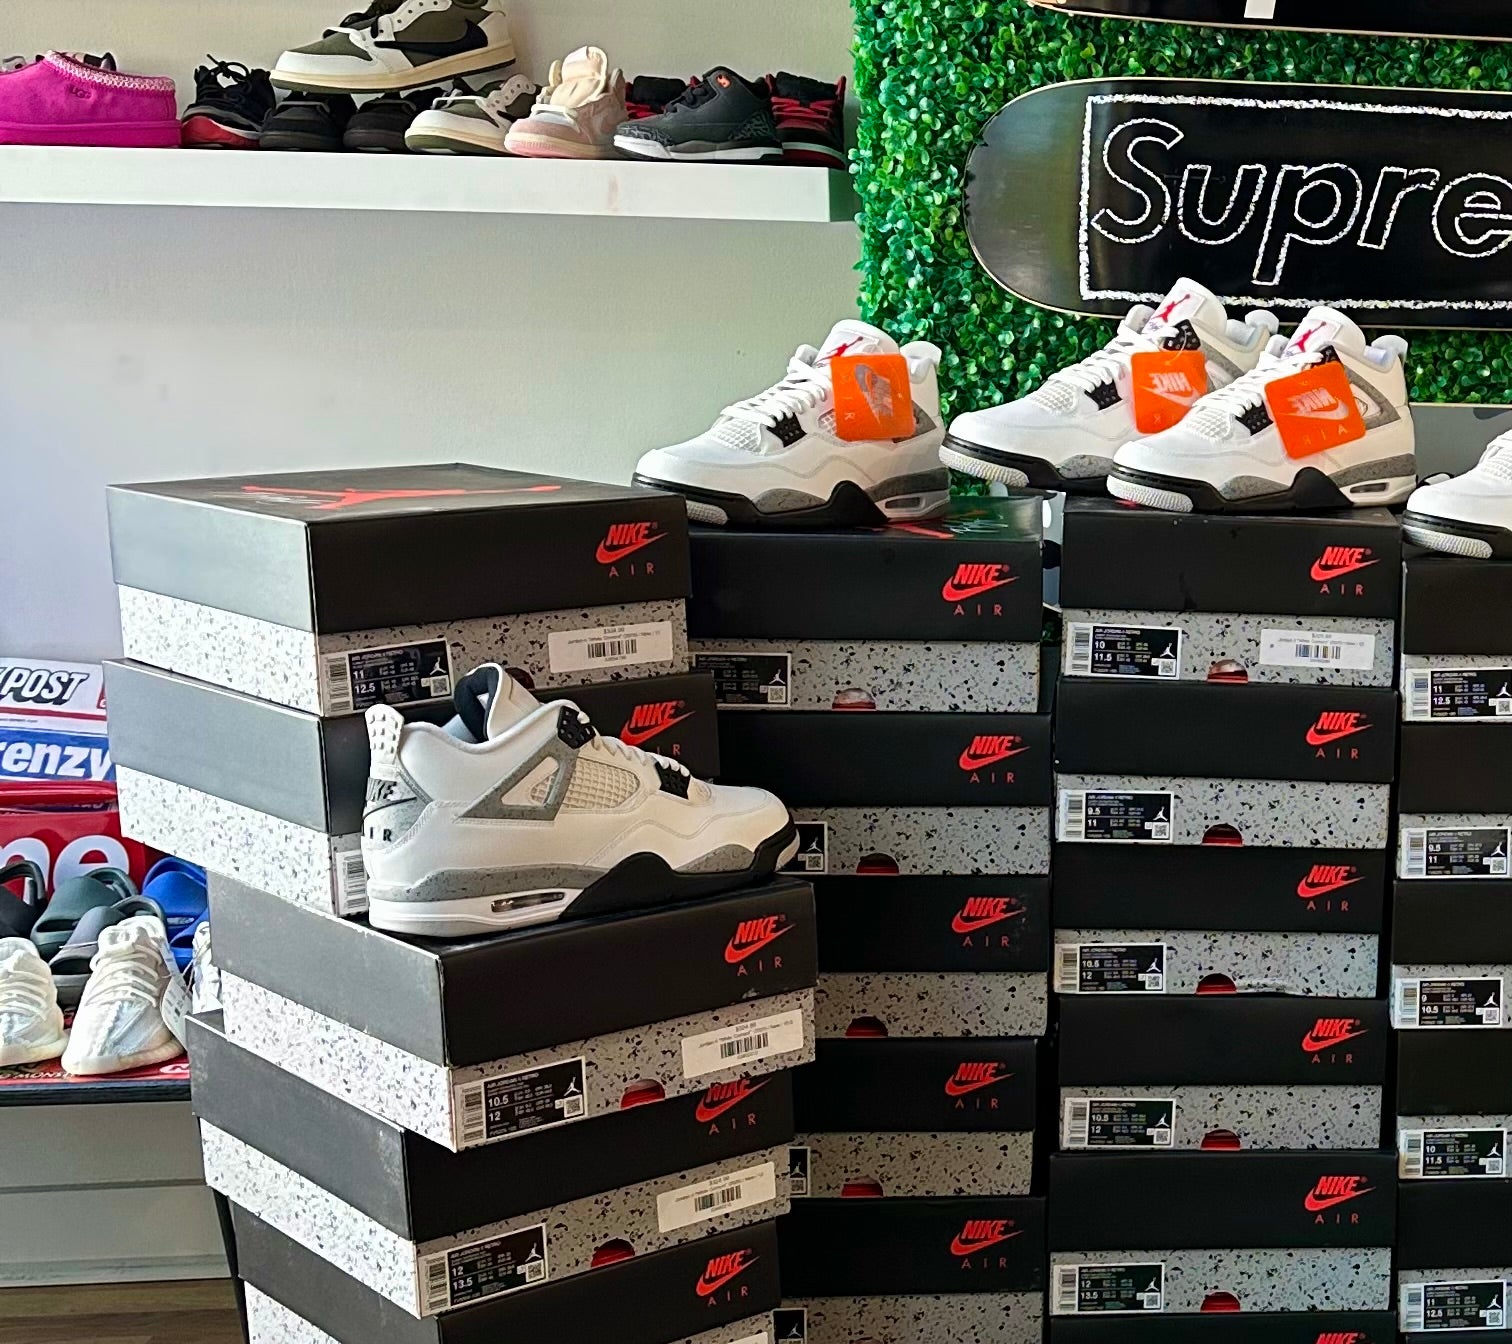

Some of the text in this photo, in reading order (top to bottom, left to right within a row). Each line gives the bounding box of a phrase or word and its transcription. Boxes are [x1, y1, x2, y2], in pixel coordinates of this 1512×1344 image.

[605, 522, 650, 546] NIKE
[1320, 546, 1365, 566] NIKE
[609, 562, 656, 578] AIR
[953, 564, 1002, 586] NIKE
[1319, 582, 1364, 595] AIR
[953, 604, 1004, 617] AIR
[352, 669, 365, 680] 11
[1, 666, 90, 706] POST
[354, 682, 376, 695] 12.5
[630, 700, 680, 728] NIKE
[1315, 712, 1361, 730] NIKE
[969, 736, 1016, 756] NIKE
[1315, 748, 1359, 759] AIR
[969, 772, 1016, 784] AIR
[1306, 865, 1351, 883] NIKE
[962, 897, 1011, 918] NIKE
[1306, 900, 1350, 912] AIR
[734, 916, 779, 945] NIKE
[962, 935, 1010, 947] AIR
[737, 955, 783, 977] AIR
[1311, 1018, 1355, 1037] NIKE
[1311, 1054, 1354, 1064] AIR
[955, 1062, 999, 1082] NIKE
[488, 1094, 509, 1108] 10.5
[954, 1098, 1000, 1110] AIR
[489, 1110, 502, 1122] 12
[709, 1112, 757, 1135] AIR
[1314, 1176, 1361, 1195] NIKE
[1314, 1213, 1361, 1225] AIR
[961, 1220, 1008, 1240] NIKE
[452, 1265, 464, 1277] 12
[704, 1250, 747, 1280] NIKE
[961, 1257, 1008, 1269] AIR
[453, 1276, 473, 1291] 13.5
[708, 1285, 749, 1306] AIR
